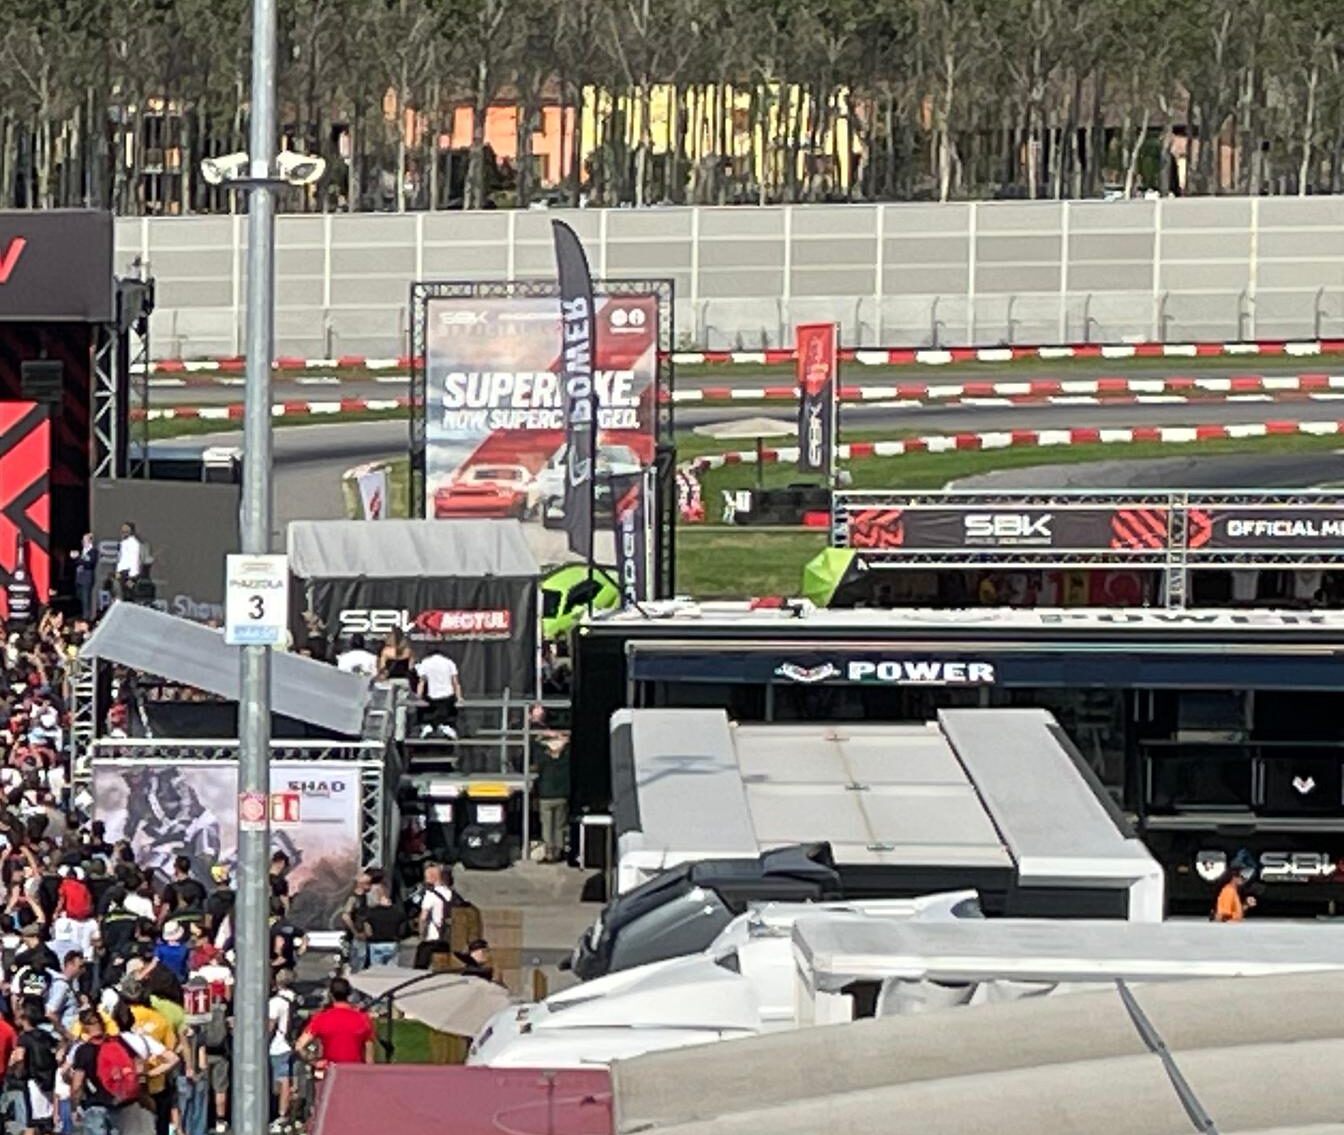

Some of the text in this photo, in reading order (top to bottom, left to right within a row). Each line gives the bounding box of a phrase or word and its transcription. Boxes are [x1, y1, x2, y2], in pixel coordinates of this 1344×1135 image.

[442, 370, 641, 408] SUPERKE.
[442, 408, 641, 430] NOW SUPERCGED.
[964, 513, 1053, 537] SBK
[1227, 519, 1319, 537] OFFICIAL
[248, 595, 266, 620] 3
[339, 609, 509, 633] SBK MOTUL
[848, 660, 995, 682] POWER
